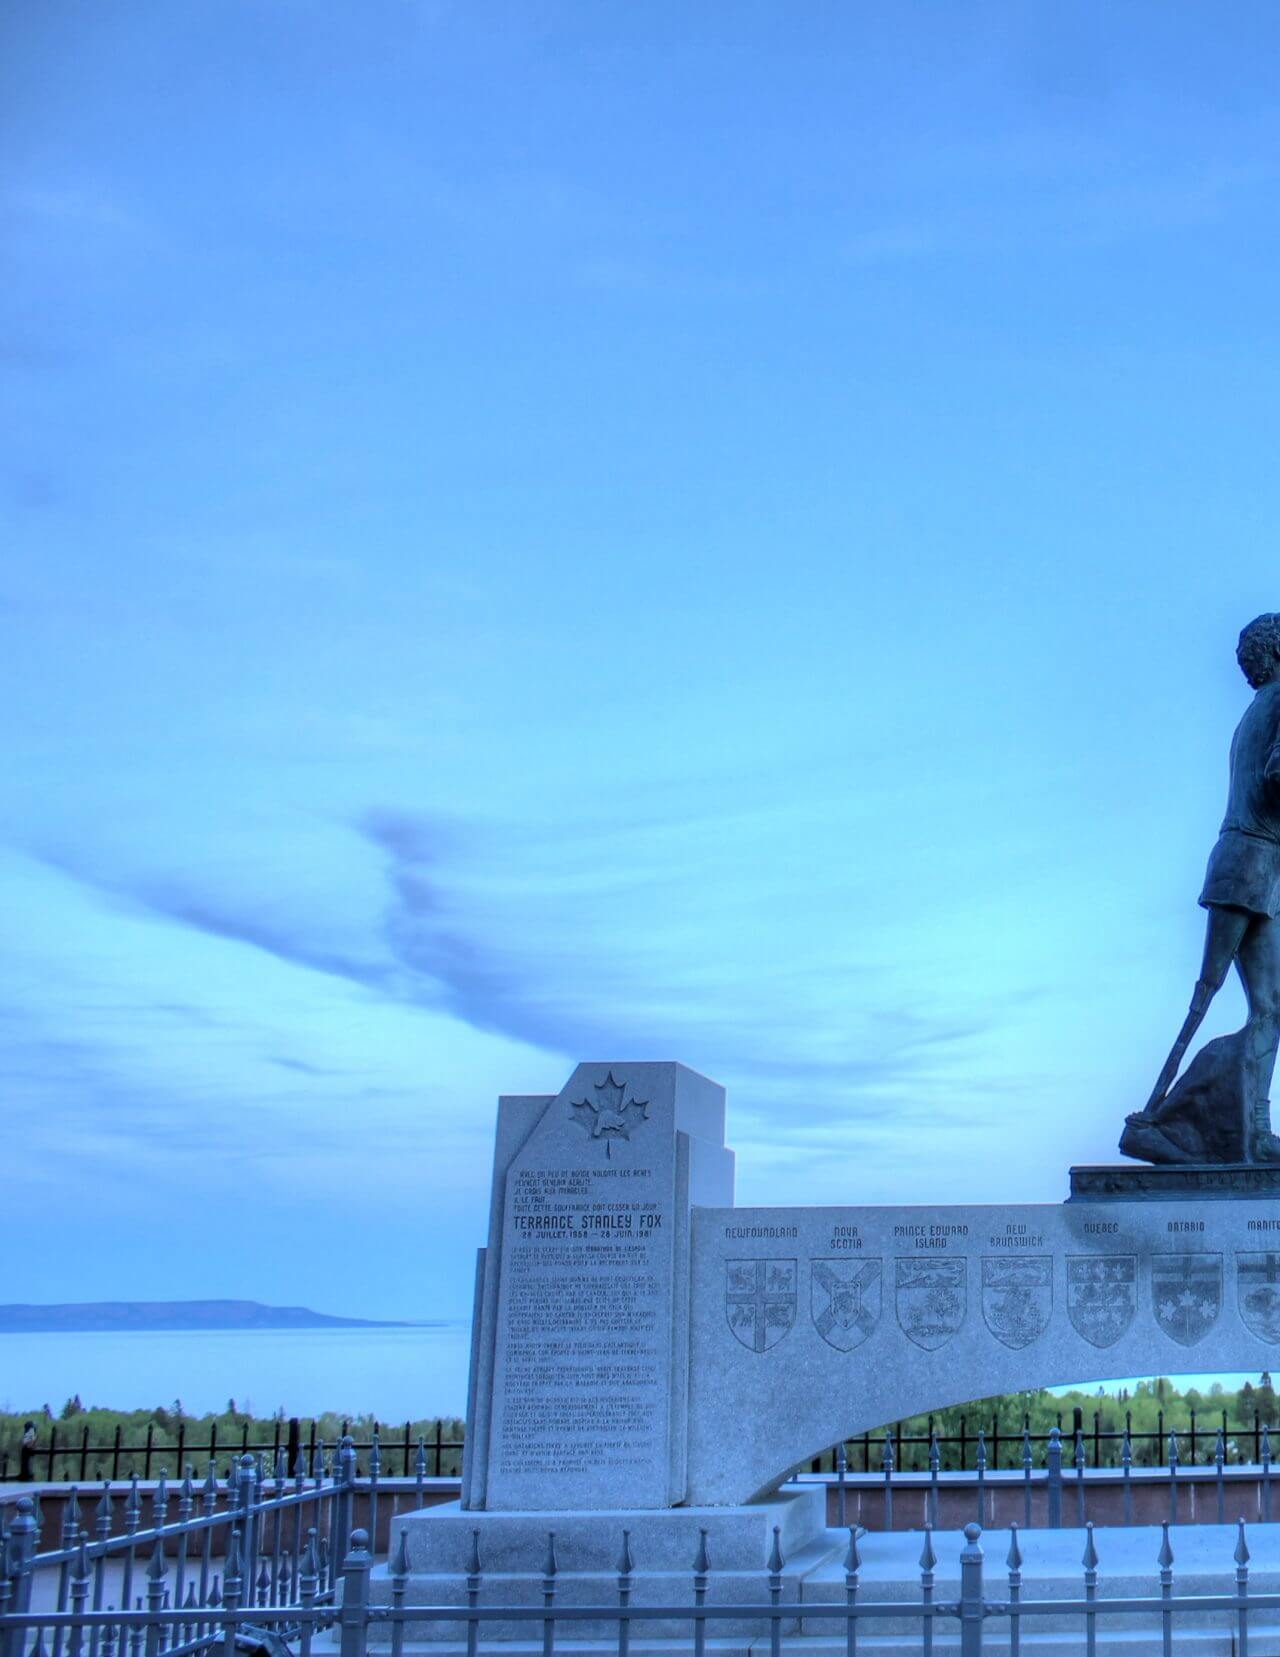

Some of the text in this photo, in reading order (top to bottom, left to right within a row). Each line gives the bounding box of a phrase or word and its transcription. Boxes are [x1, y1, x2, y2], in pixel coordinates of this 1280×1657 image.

[514, 1214, 662, 1230] TERRANCE STANLEY FOX
[1083, 1222, 1119, 1233] QUEBEC
[1167, 1222, 1205, 1232] ONTARIO
[600, 1230, 610, 1239] 28
[725, 1226, 798, 1238] NEWFOUNDLAND
[834, 1226, 858, 1238] NOVA
[894, 1225, 969, 1237] PRINCE EDWARD
[1006, 1224, 1026, 1235] NEW
[830, 1238, 862, 1249] SCOTIA
[915, 1237, 947, 1249] ISLAND
[990, 1236, 1044, 1248] BRUNSWICK
